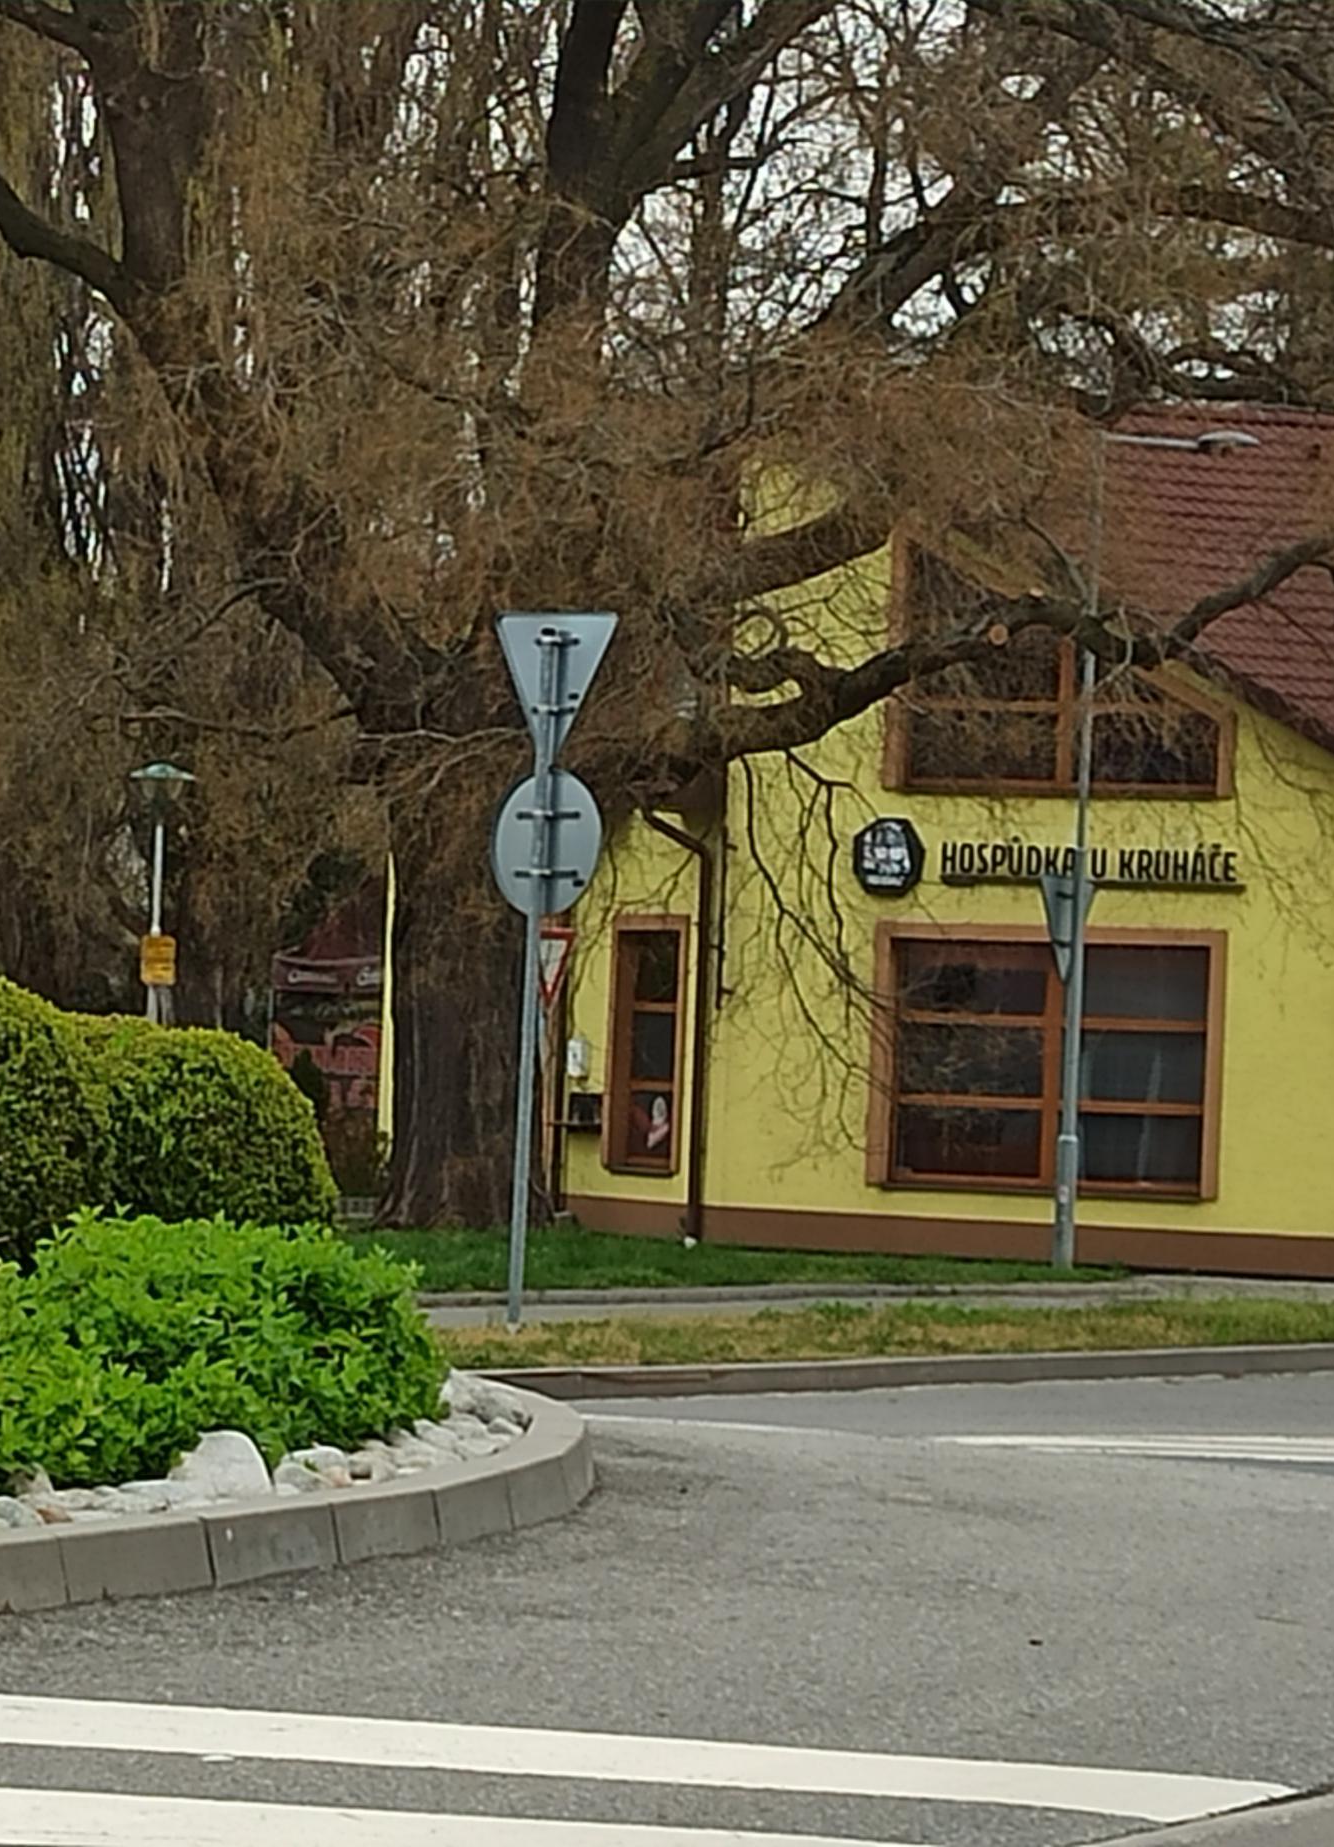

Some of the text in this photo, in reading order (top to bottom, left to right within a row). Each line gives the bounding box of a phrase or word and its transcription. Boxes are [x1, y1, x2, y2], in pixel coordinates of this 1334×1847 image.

[941, 836, 1237, 882] HOSPŮDKA U KRUHÁČE
